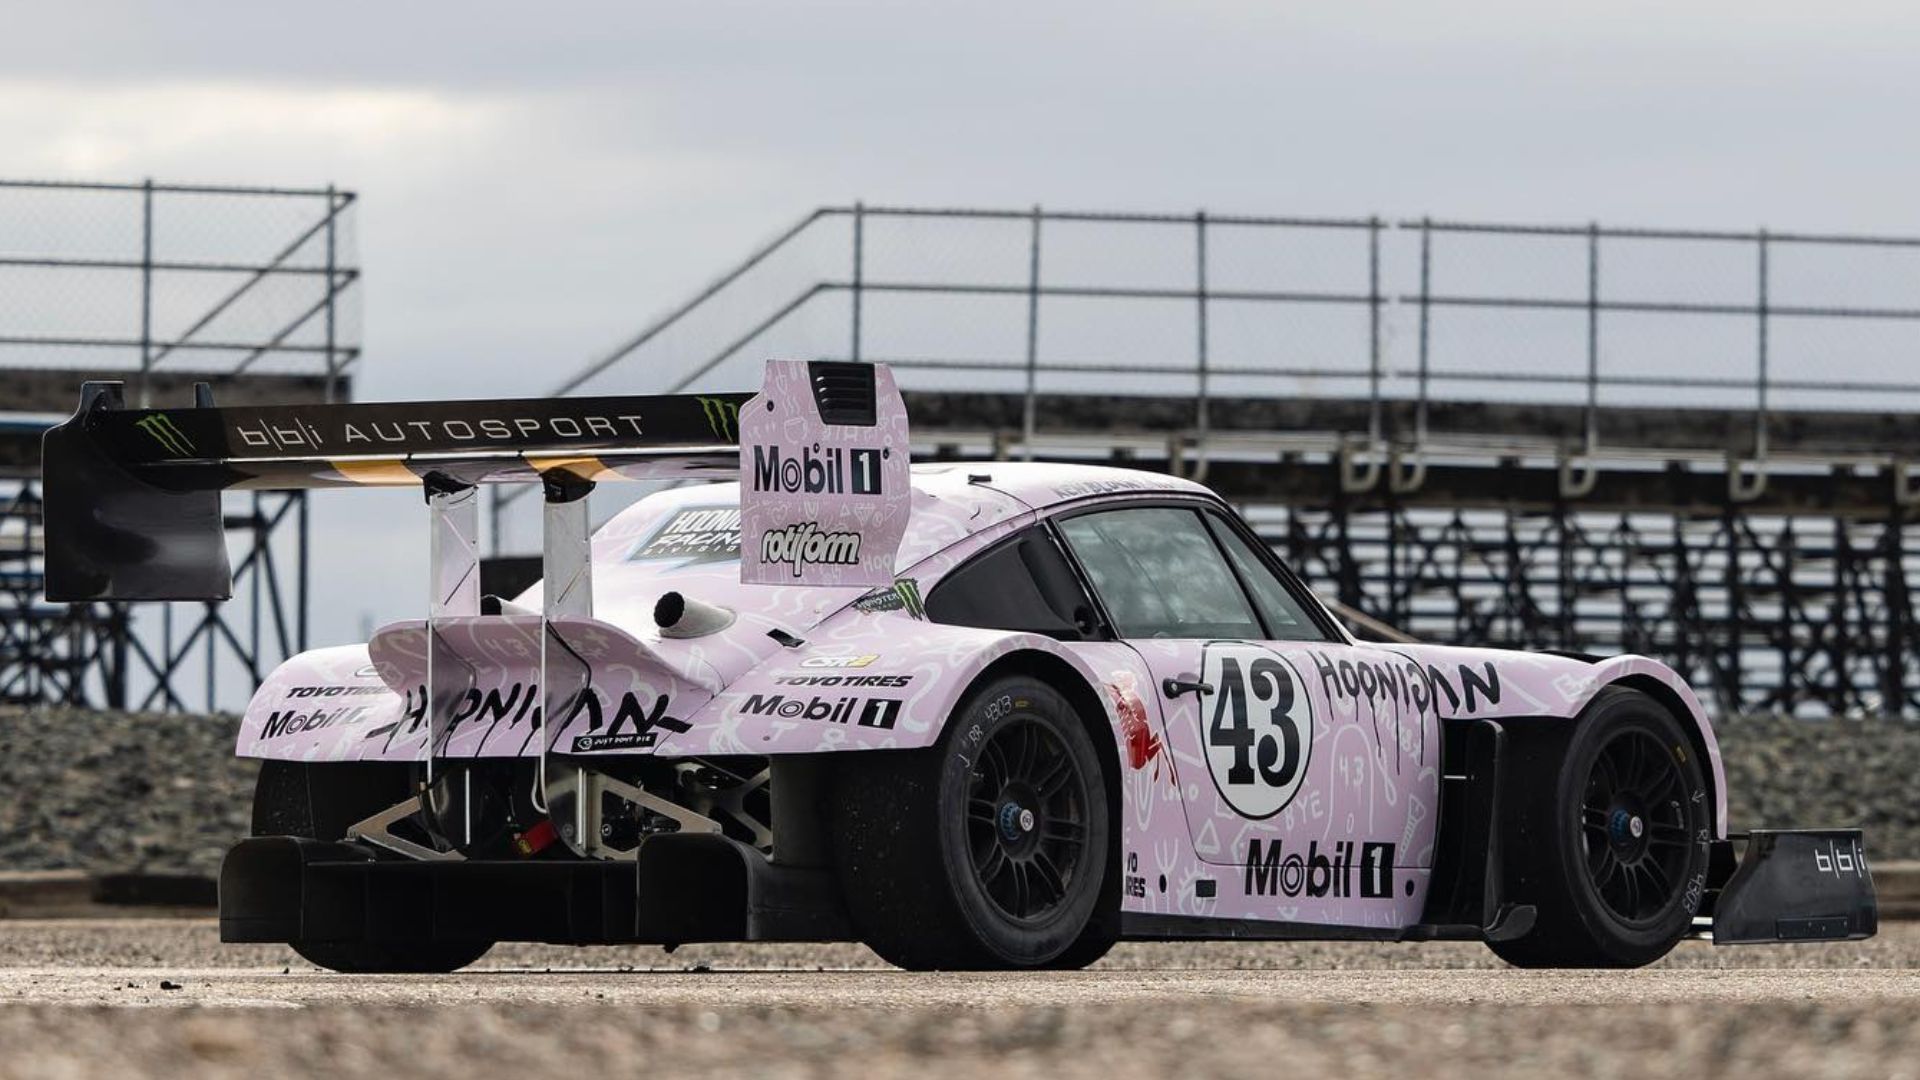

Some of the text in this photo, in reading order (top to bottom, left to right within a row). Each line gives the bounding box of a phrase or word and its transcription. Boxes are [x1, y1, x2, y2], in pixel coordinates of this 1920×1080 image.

[345, 414, 643, 444] AUTOSPORT
[753, 445, 844, 494] Mobil
[761, 522, 863, 577] rotiform
[286, 686, 343, 699] TOYO
[775, 675, 914, 688] TOYO TIRES
[260, 707, 348, 740] Mobil
[740, 695, 858, 724] Mobil
[1210, 657, 1300, 788] 43
[1245, 839, 1354, 898] Mobil
